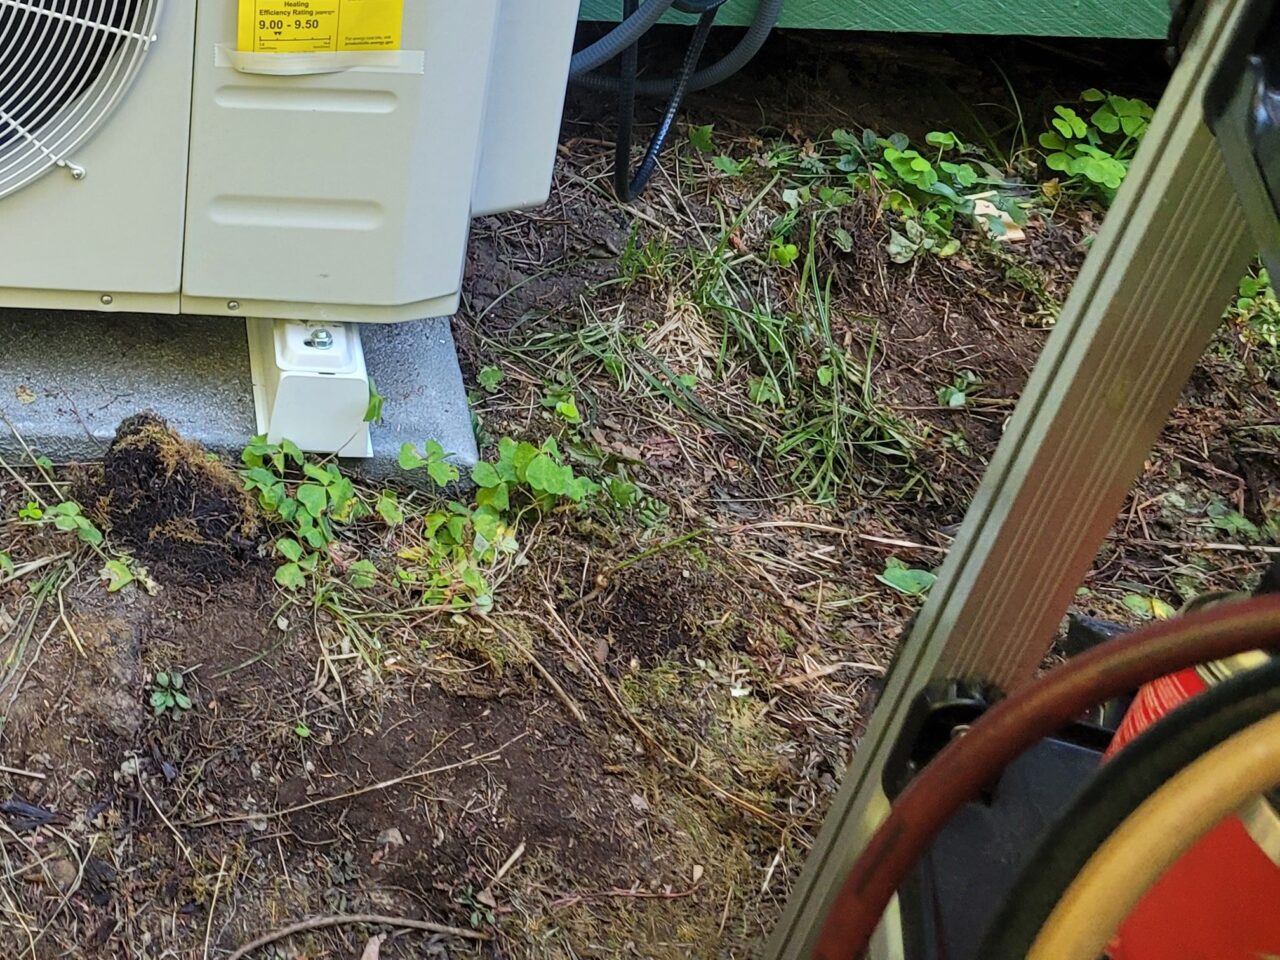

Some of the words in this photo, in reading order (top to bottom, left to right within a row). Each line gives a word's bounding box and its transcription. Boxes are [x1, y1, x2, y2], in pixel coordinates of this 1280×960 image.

[259, 9, 291, 17] Efficiency
[259, 19, 283, 30] 9.00
[294, 19, 319, 29] 9.50
